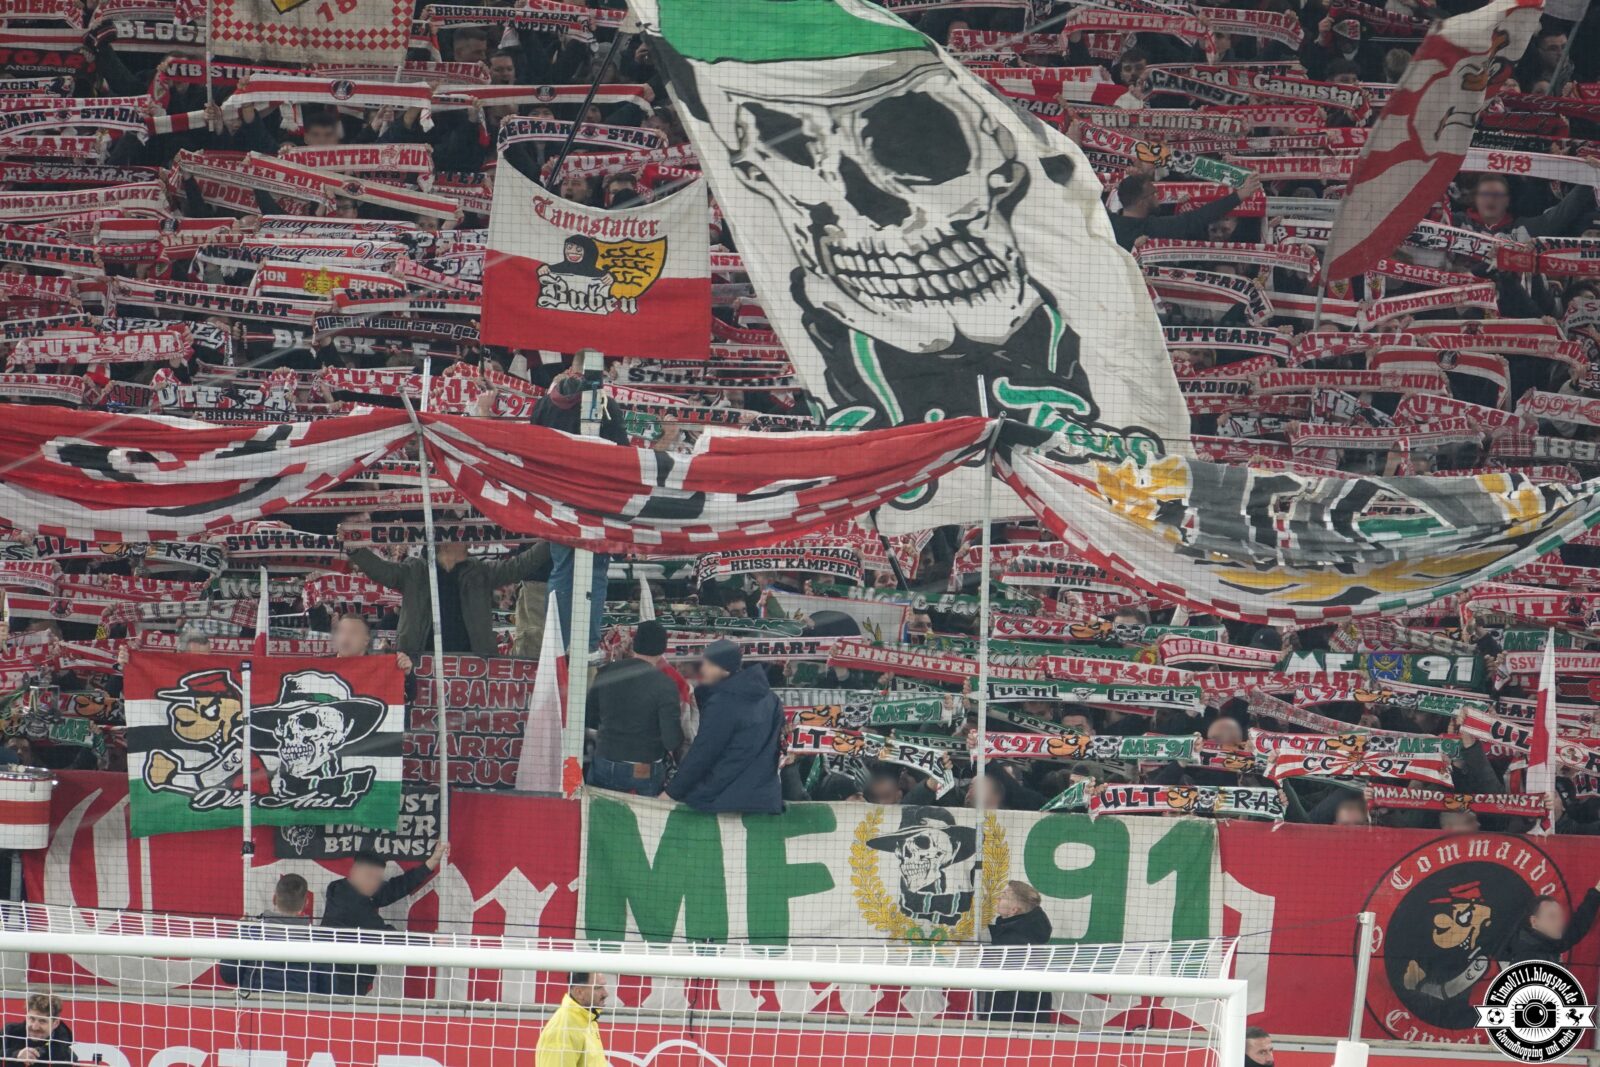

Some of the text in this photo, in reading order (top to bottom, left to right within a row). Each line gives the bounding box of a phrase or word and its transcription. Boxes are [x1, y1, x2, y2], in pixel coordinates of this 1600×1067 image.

[104, 188, 160, 202] KURVE
[532, 195, 661, 238] Cannstatter
[1393, 262, 1476, 286] Stuttgart
[153, 289, 292, 316] STUTTGART
[536, 273, 639, 315] Buben
[1259, 371, 1382, 388] CANNSTATTER
[731, 559, 780, 573] HEISST
[413, 655, 539, 679] JEDER
[1416, 654, 1475, 682] 91
[1509, 655, 1537, 669] SSV
[1377, 758, 1411, 775] 97
[1100, 785, 1160, 809] ULT
[323, 835, 361, 854] BEI
[1390, 838, 1557, 898] Commando
[584, 801, 837, 955] MF
[1023, 814, 1219, 977] 91
